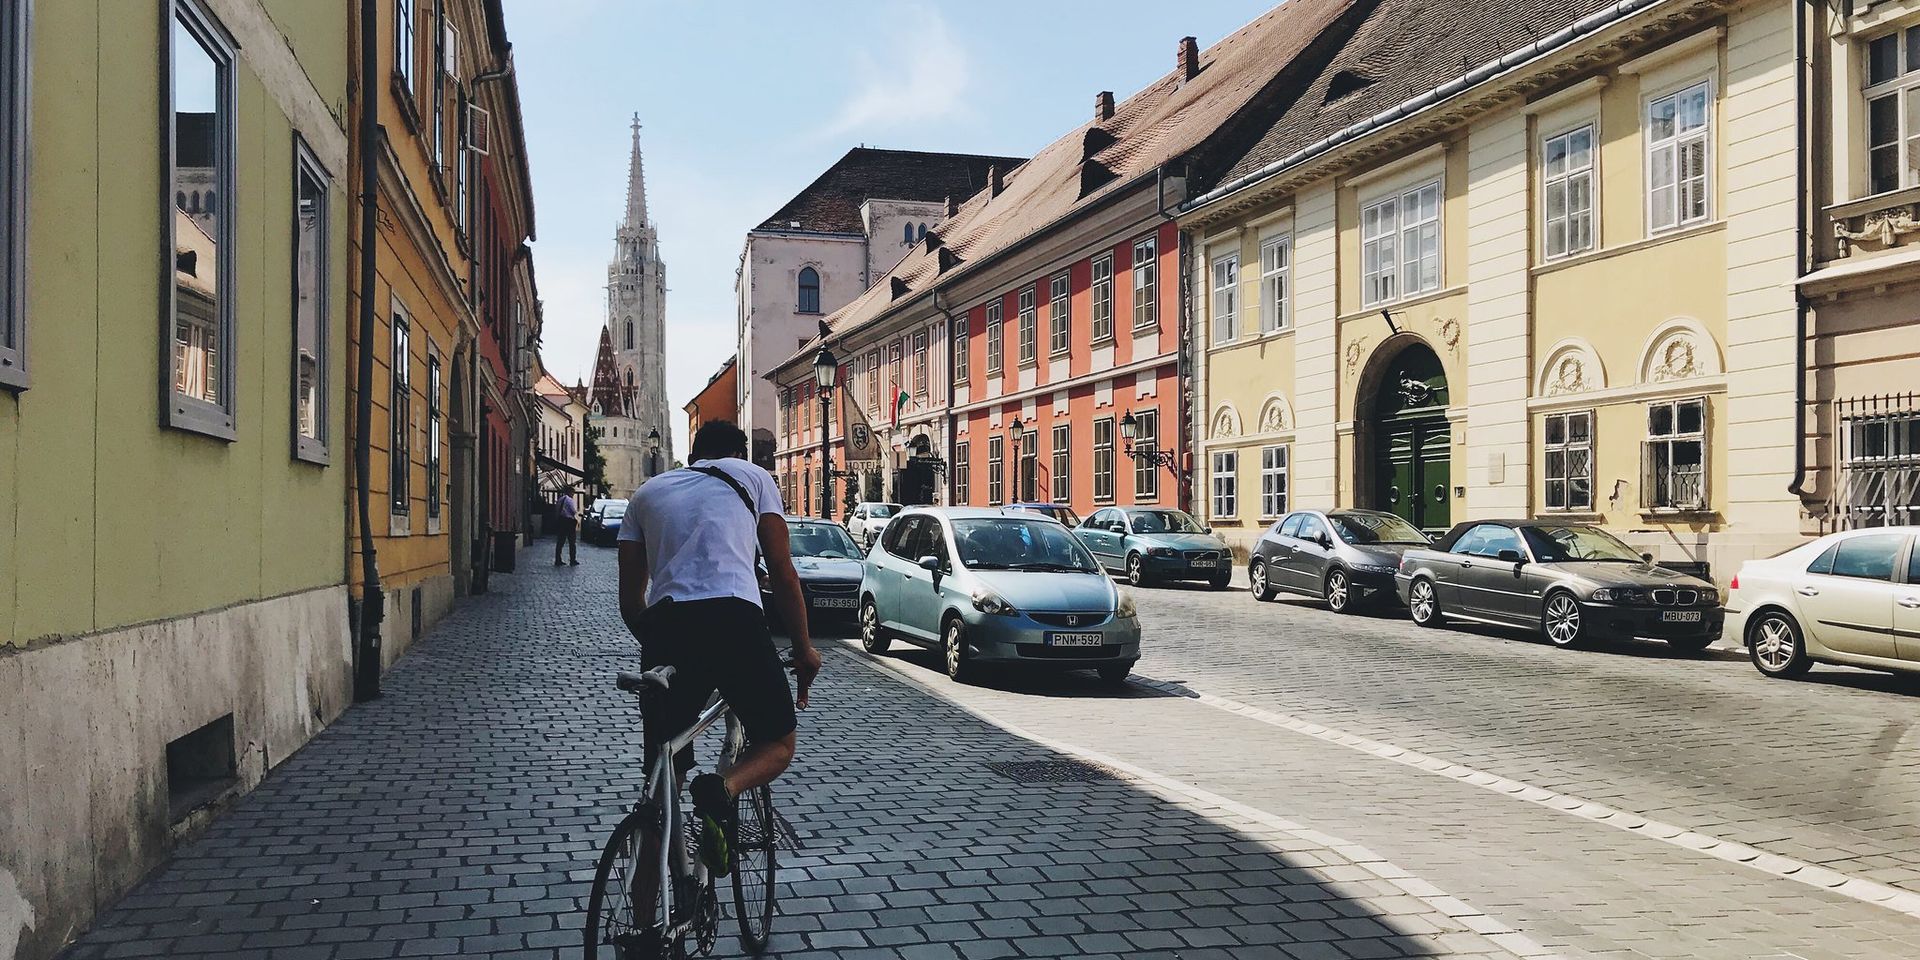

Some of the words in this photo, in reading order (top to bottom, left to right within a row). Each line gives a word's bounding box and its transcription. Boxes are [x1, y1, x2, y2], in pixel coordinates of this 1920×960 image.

[819, 598, 857, 608] GTS-950
[1664, 612, 1700, 621] MBU-073
[1053, 634, 1100, 645] PNM-592
